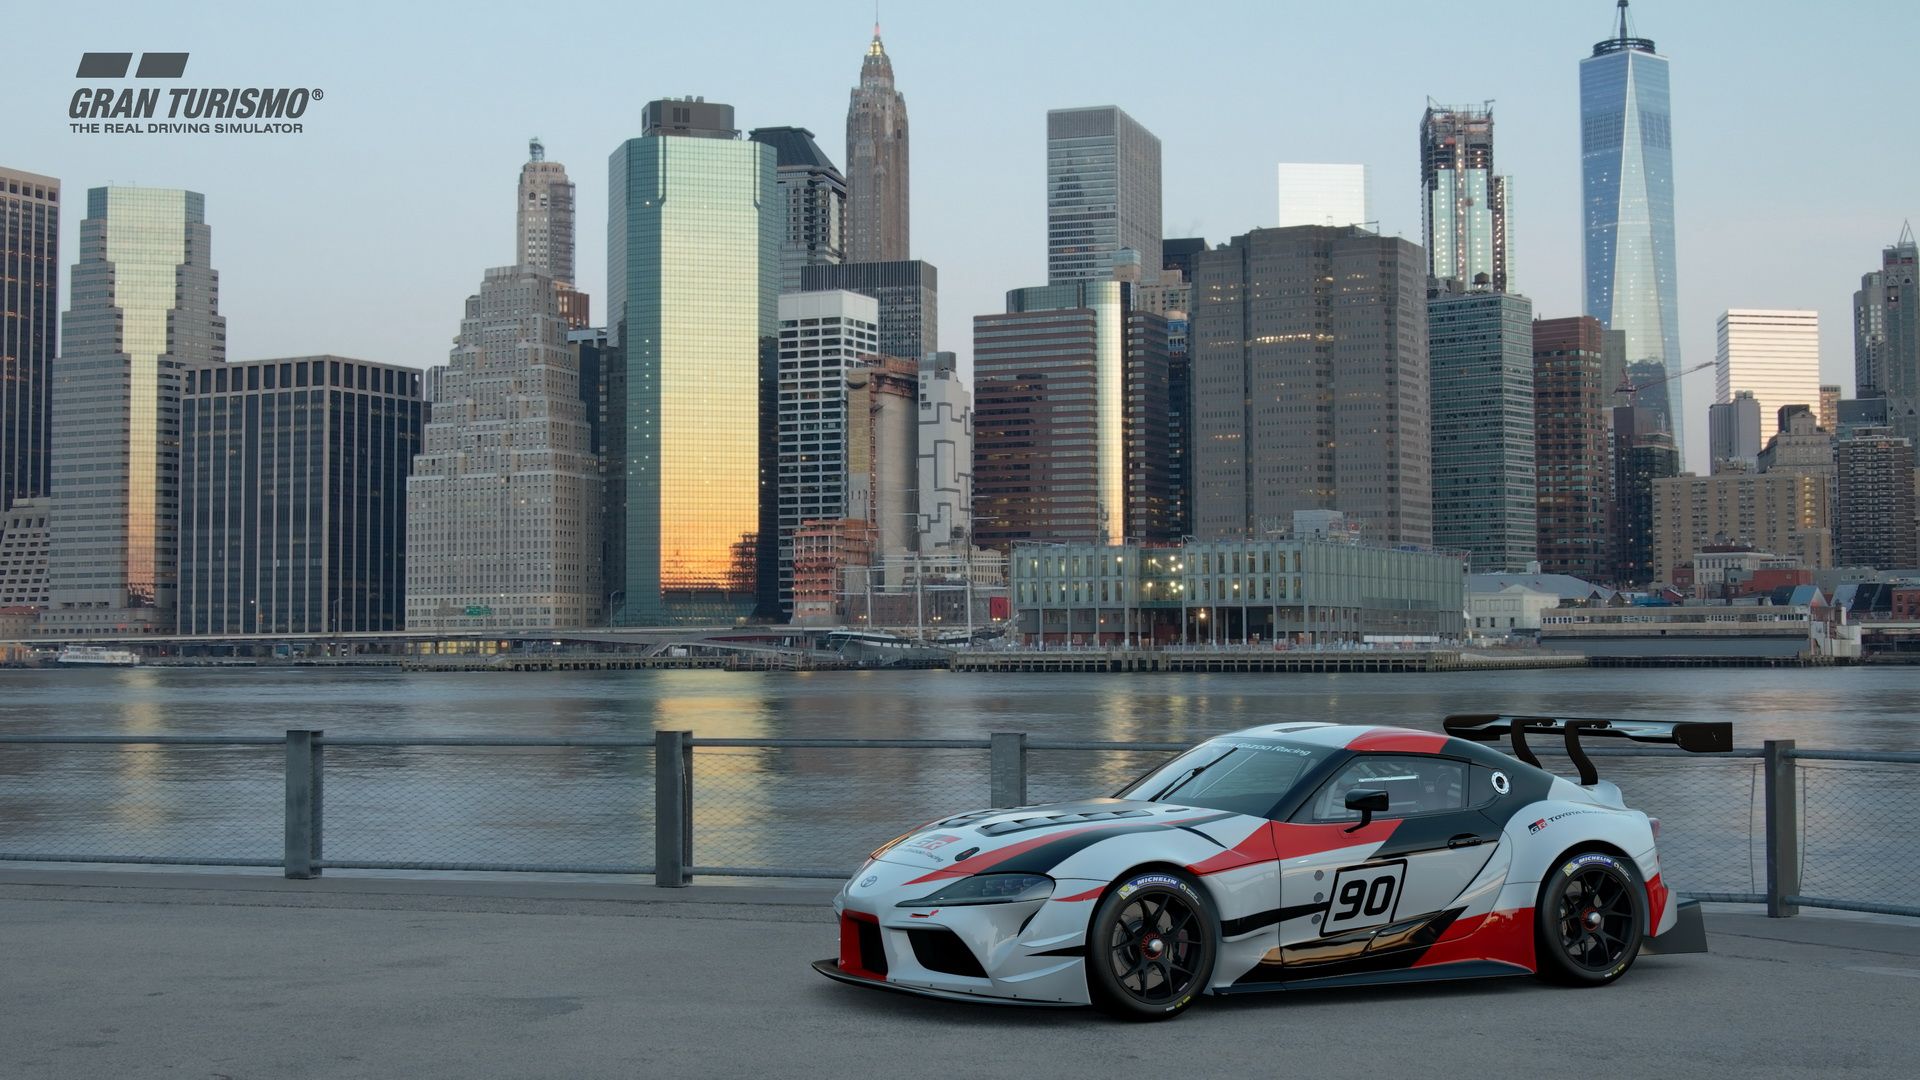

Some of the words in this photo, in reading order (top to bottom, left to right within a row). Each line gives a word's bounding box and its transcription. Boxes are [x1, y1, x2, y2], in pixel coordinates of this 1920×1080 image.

[1272, 745, 1311, 757] Racing
[1548, 810, 1581, 823] TOYOTA
[1578, 855, 1612, 864] MICHELIN
[1136, 876, 1178, 885] MICHELIN
[1333, 875, 1396, 921] 90
